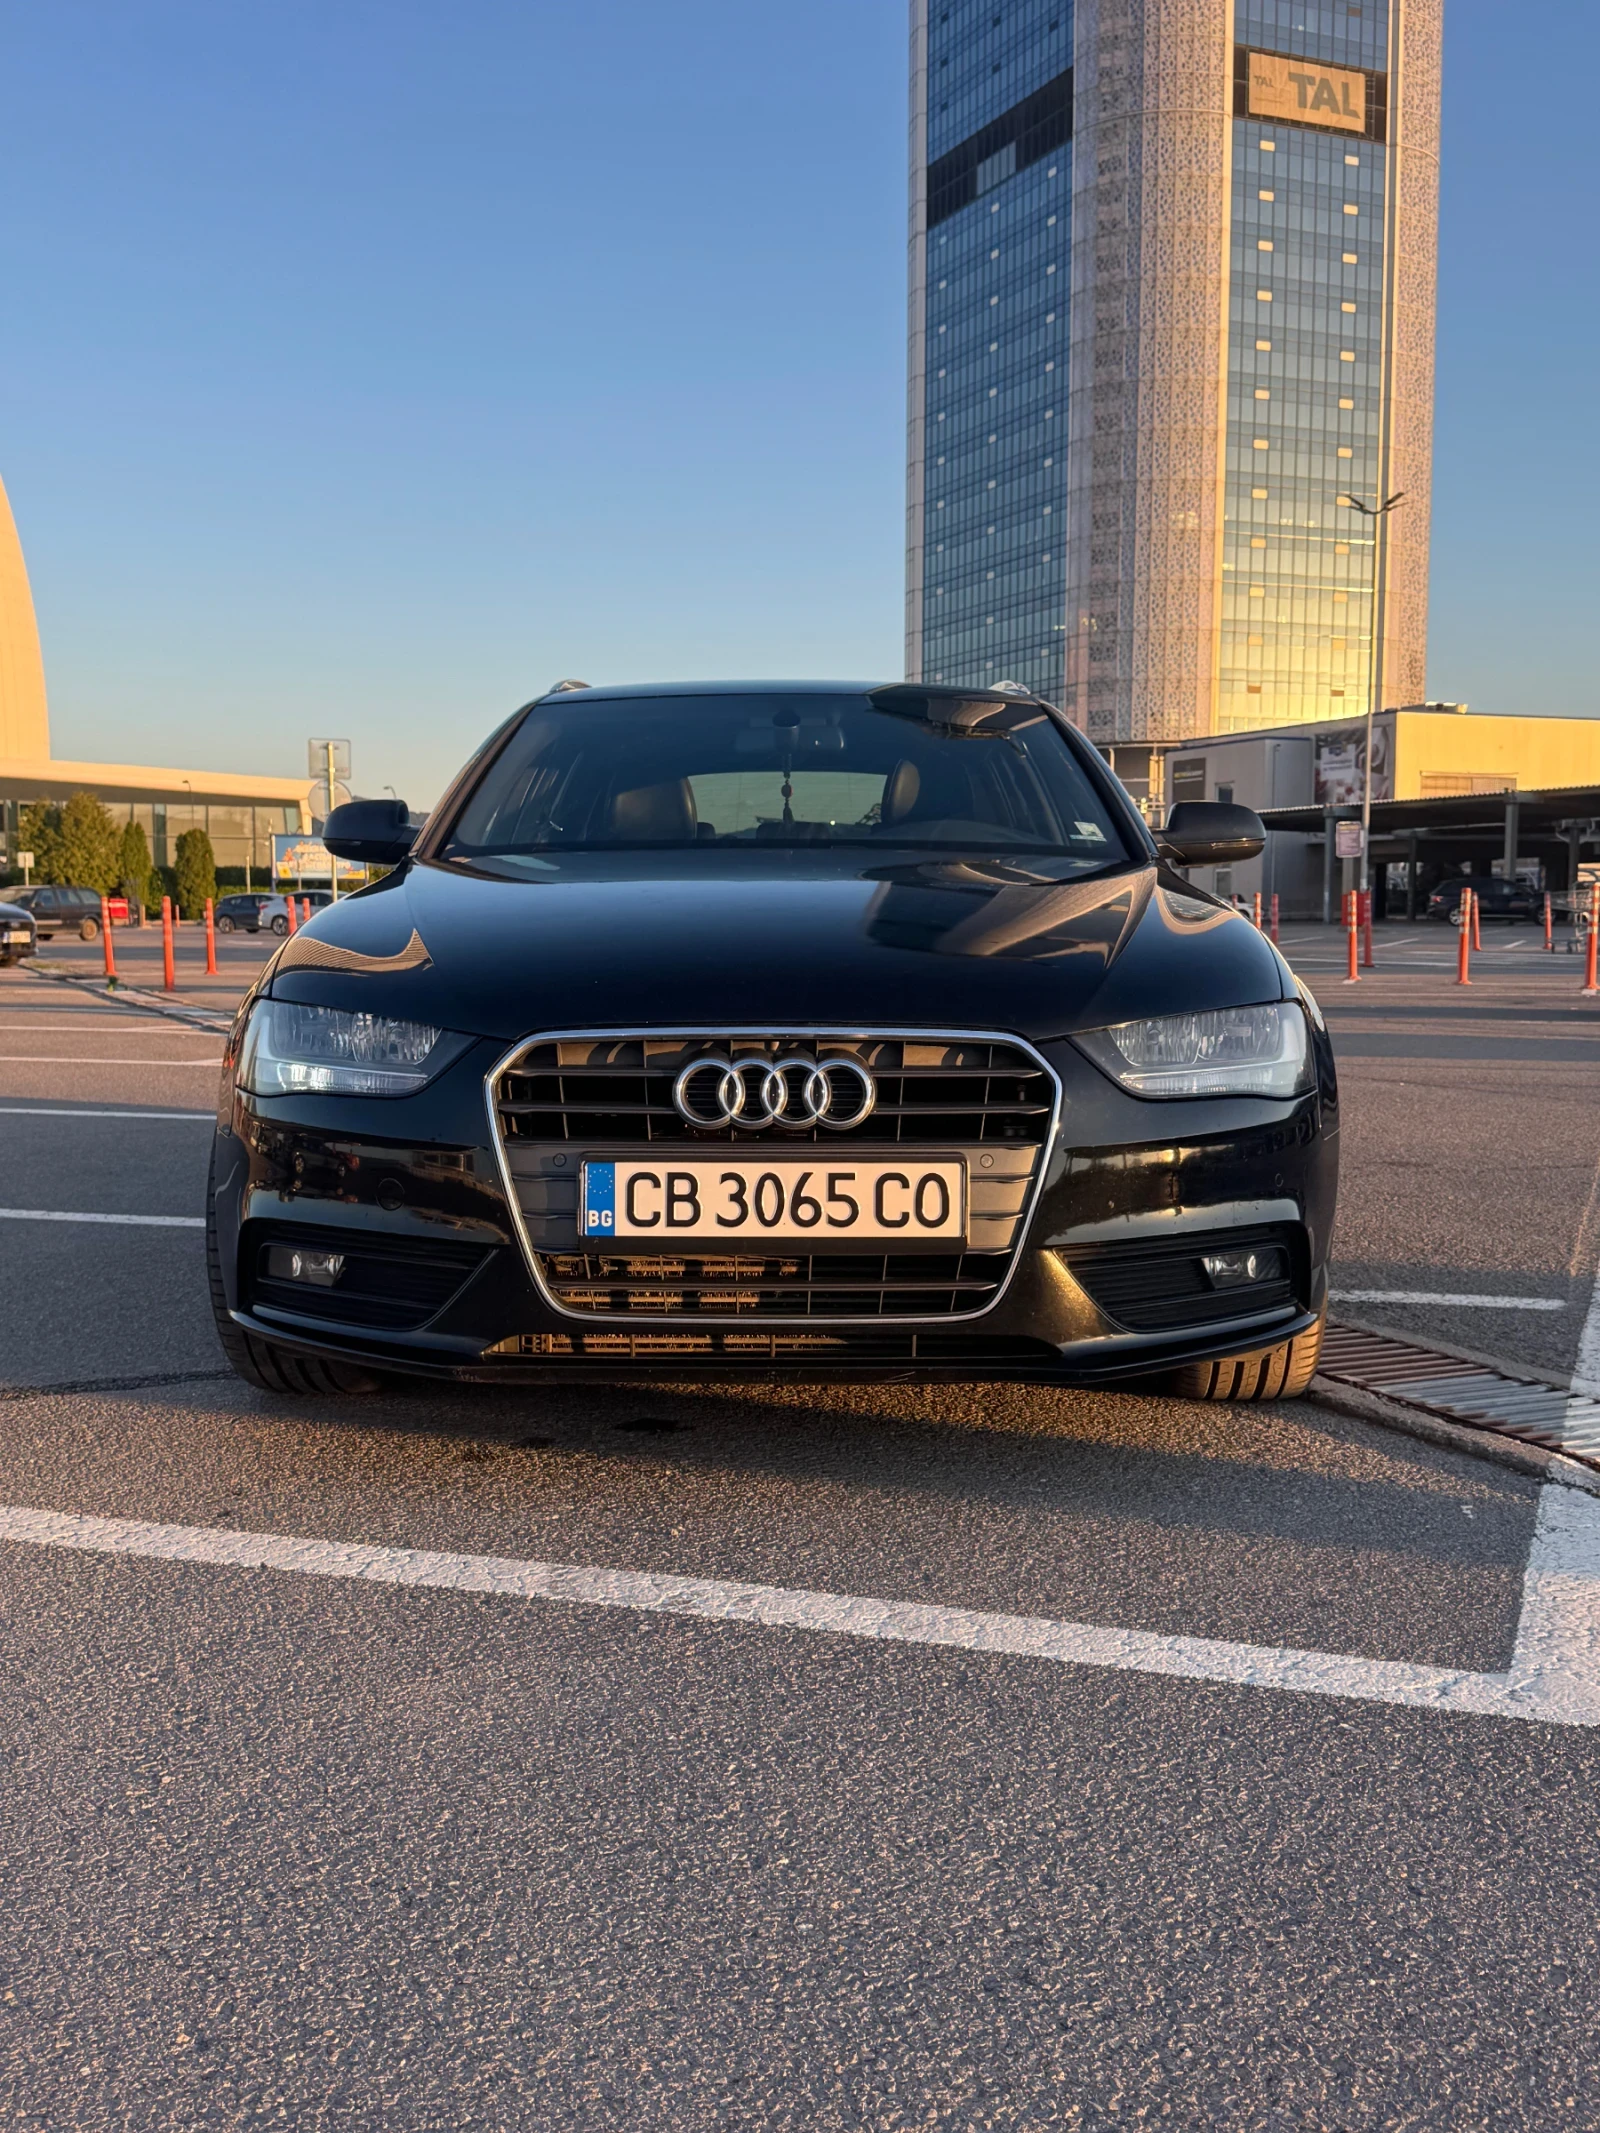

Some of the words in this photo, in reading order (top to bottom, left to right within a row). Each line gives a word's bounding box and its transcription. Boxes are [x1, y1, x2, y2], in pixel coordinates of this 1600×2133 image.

[1288, 72, 1361, 119] TAL
[588, 1210, 612, 1227] BG
[626, 1172, 701, 1228] CB
[716, 1172, 859, 1228] 3065
[875, 1172, 950, 1228] CO
